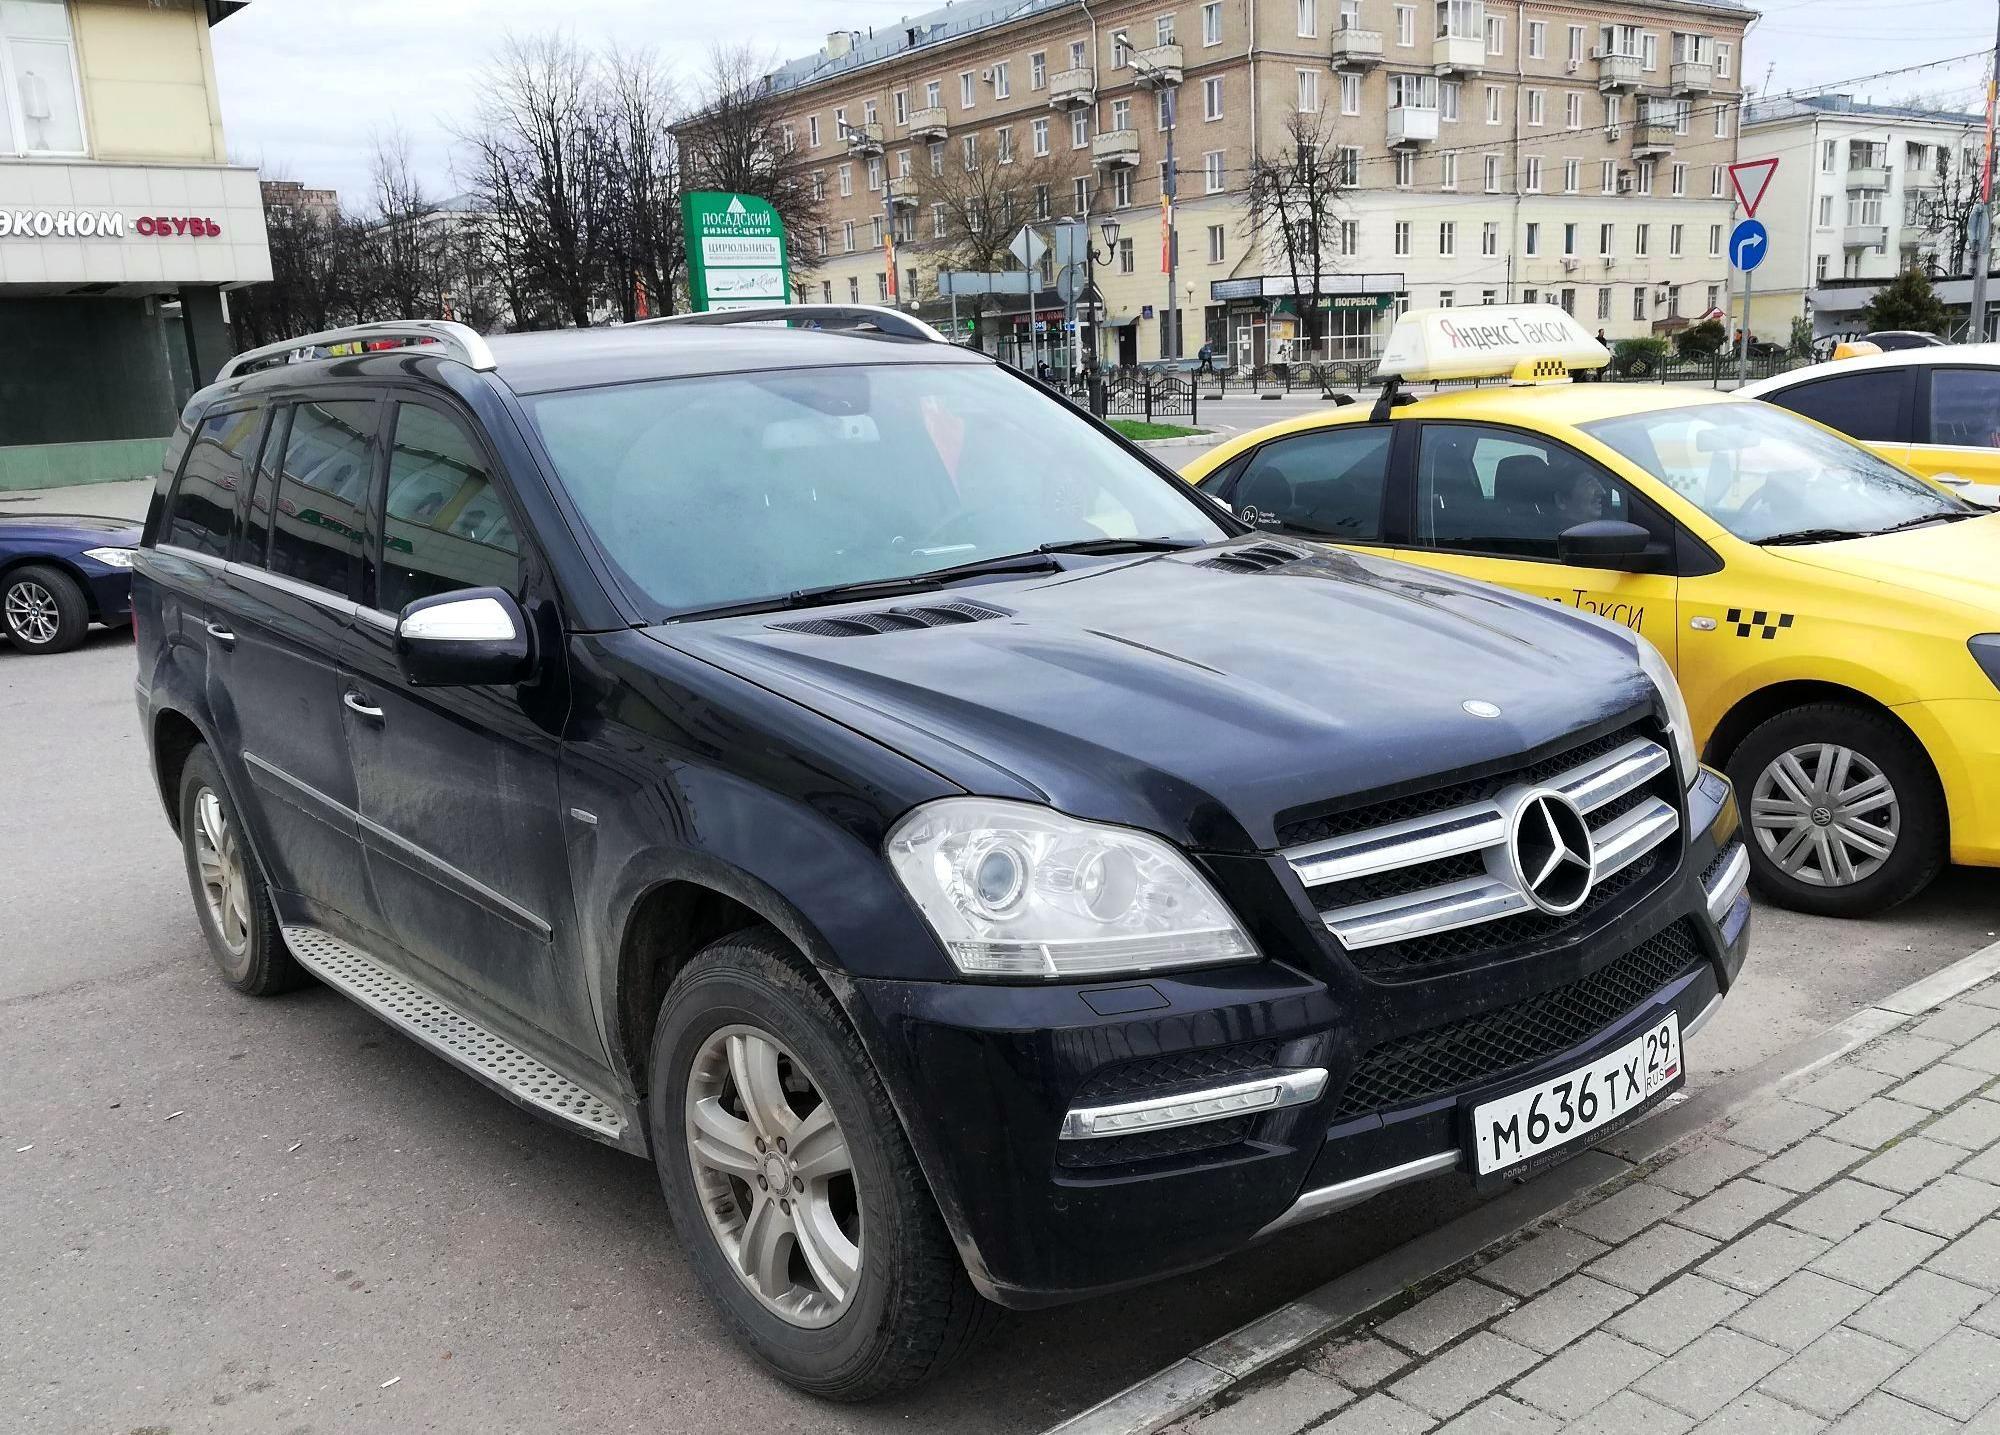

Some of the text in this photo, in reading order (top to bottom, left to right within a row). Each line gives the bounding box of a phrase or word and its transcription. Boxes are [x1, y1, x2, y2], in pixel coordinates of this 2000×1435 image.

[0, 210, 221, 237] ЭКОНОМ ОБУВЬ
[702, 210, 771, 227] ПОСАДСКИЙ
[703, 227, 771, 235] БИЗНЕС-ЦЕНТР
[708, 243, 776, 253] ЦИРЮЛЬНИКЪ
[1335, 296, 1377, 307] ПОГРЕБОК
[1440, 317, 1574, 350] Яндекс Такси
[1647, 1025, 1671, 1073] 29
[1646, 1068, 1665, 1089] RUS
